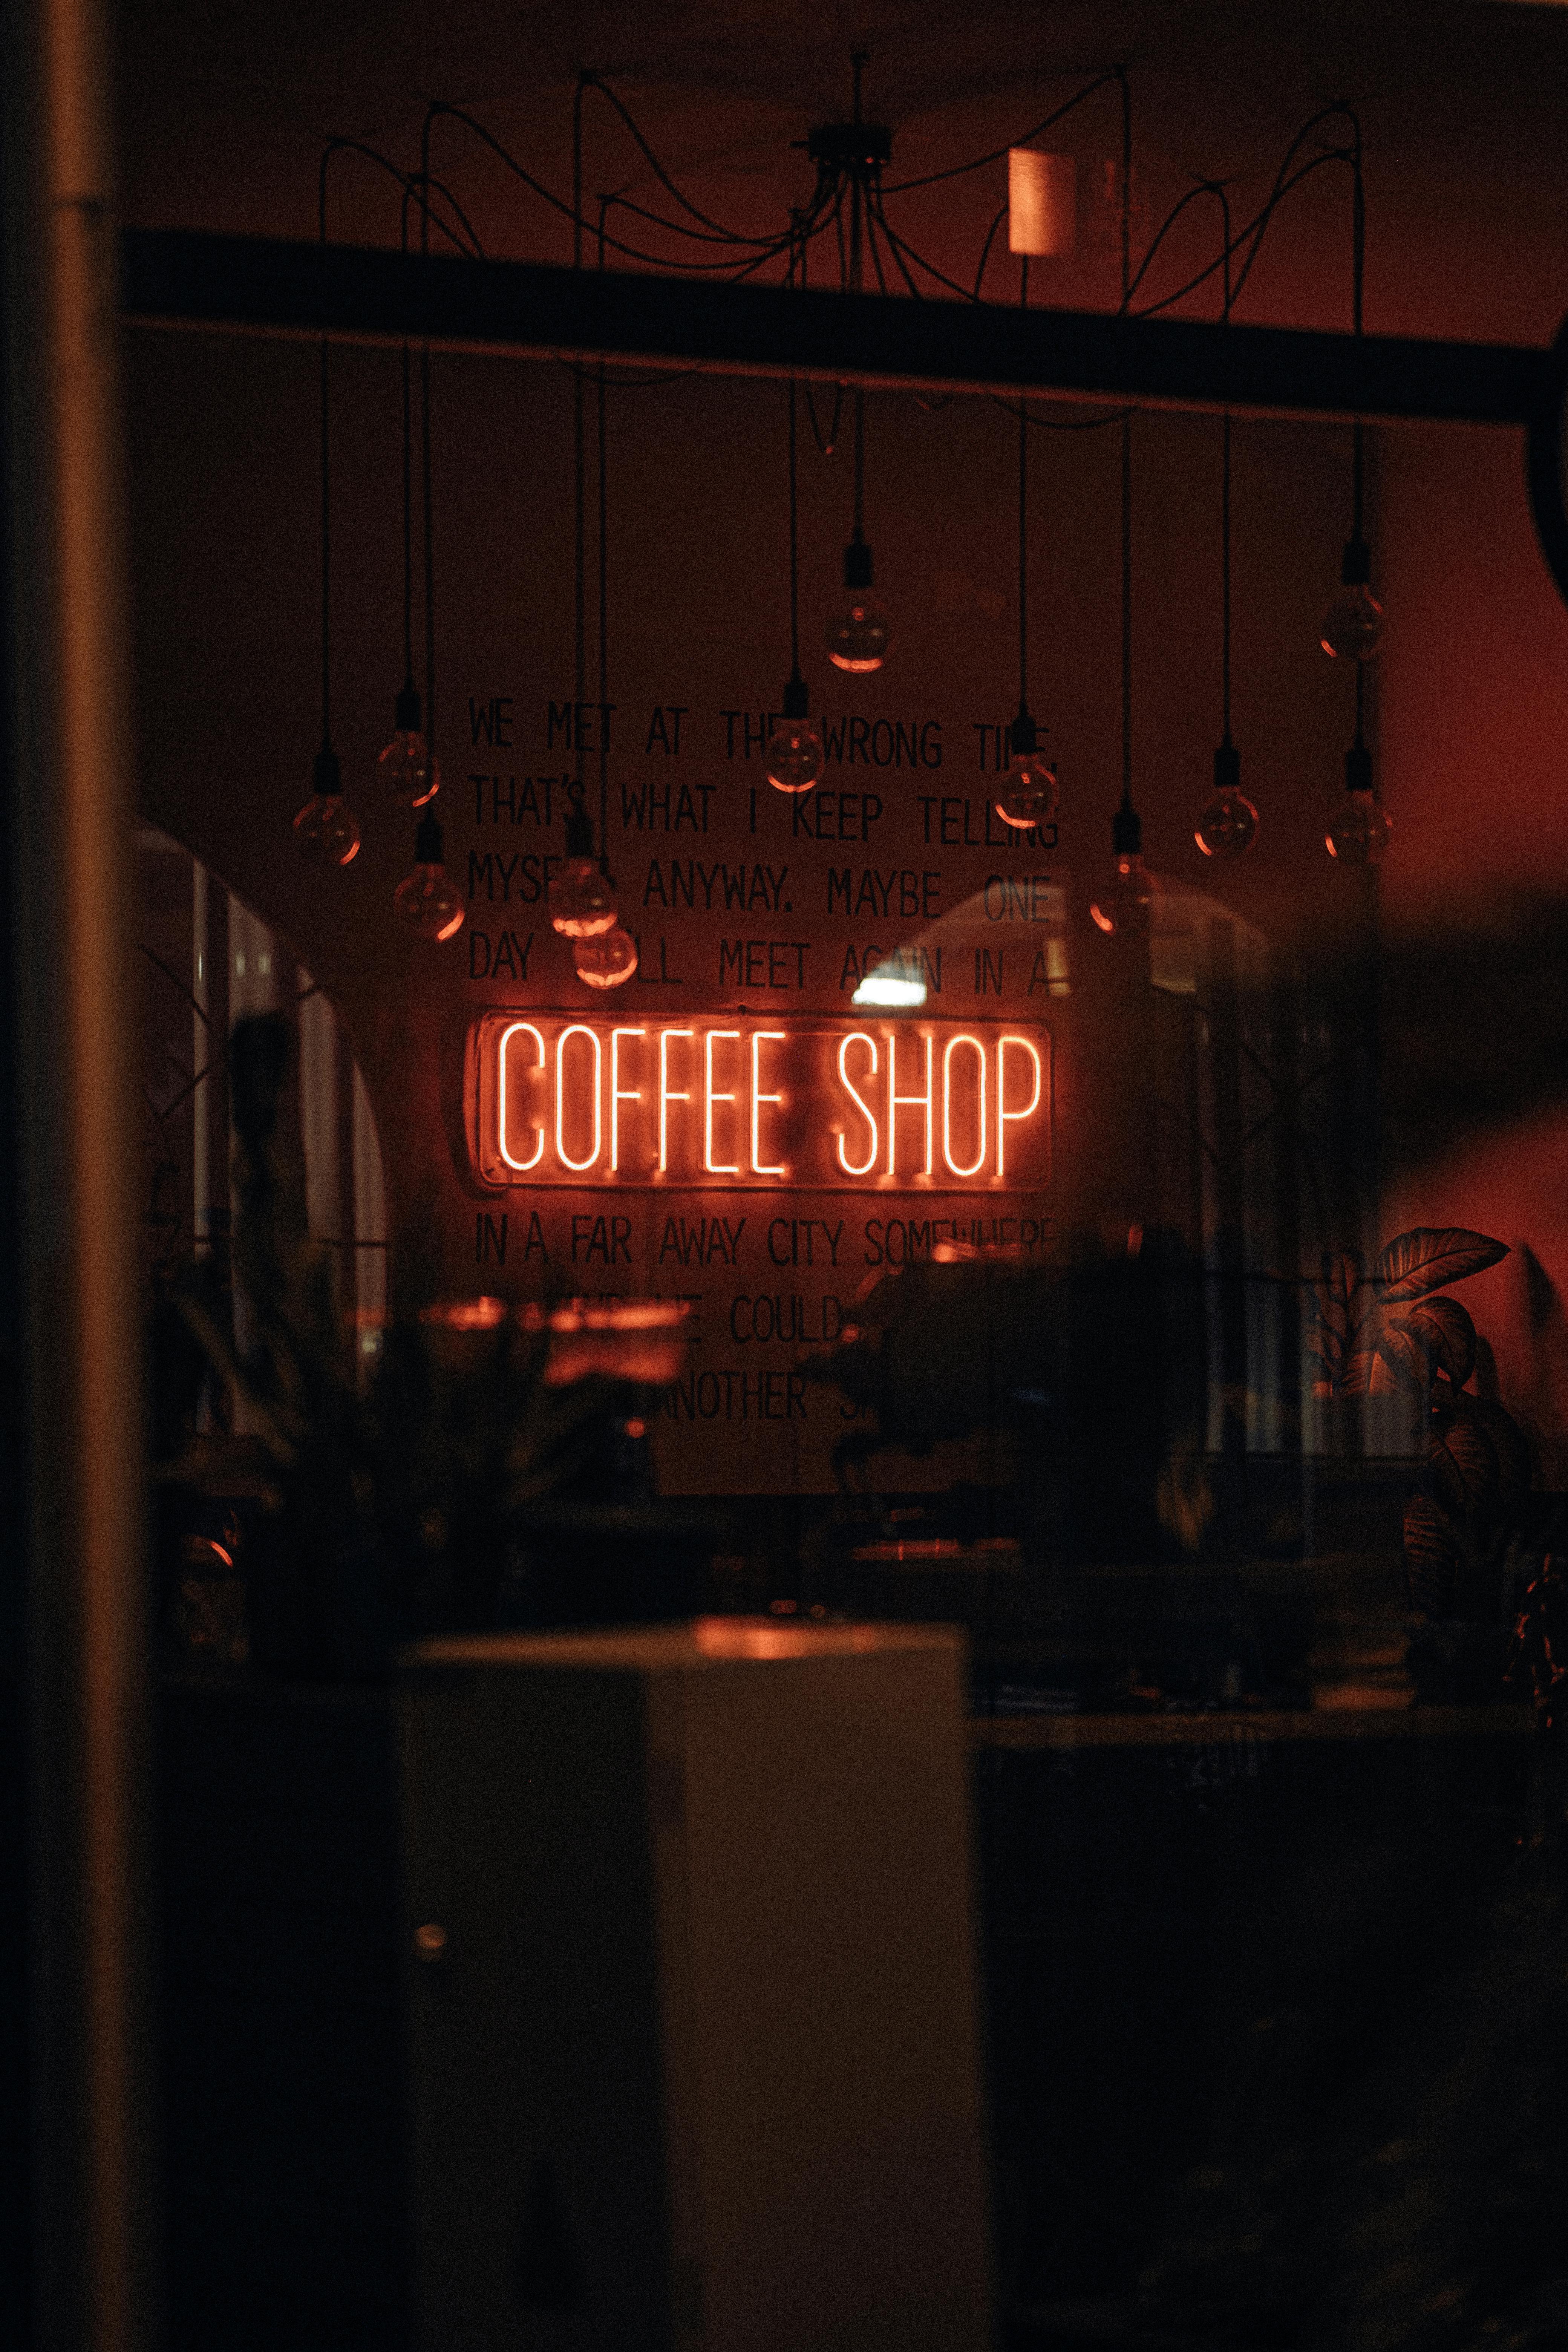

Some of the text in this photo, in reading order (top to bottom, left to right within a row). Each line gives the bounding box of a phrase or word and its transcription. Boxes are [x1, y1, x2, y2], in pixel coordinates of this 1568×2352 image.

[469, 697, 513, 747] WE
[548, 700, 617, 752] MET
[646, 707, 688, 754] AT
[822, 715, 943, 769] WRONG
[974, 723, 1058, 773] TI,
[621, 783, 716, 833] WHAT
[749, 788, 756, 833] I
[793, 790, 883, 842] KEEP
[643, 859, 793, 913] ANYWAY.
[827, 867, 942, 919] MAYBE
[983, 874, 1051, 923] ONE
[469, 930, 534, 980] DAY
[719, 938, 811, 989] MEET
[975, 947, 1003, 996] IN
[1027, 950, 1050, 997] A
[499, 1022, 1042, 1177] COFFEE SHOP
[476, 1213, 507, 1266] IN
[524, 1211, 549, 1263] A
[572, 1215, 632, 1264] FAR
[659, 1217, 746, 1266] AWAY
[767, 1217, 845, 1266] CITY
[730, 1294, 843, 1344] COULD
